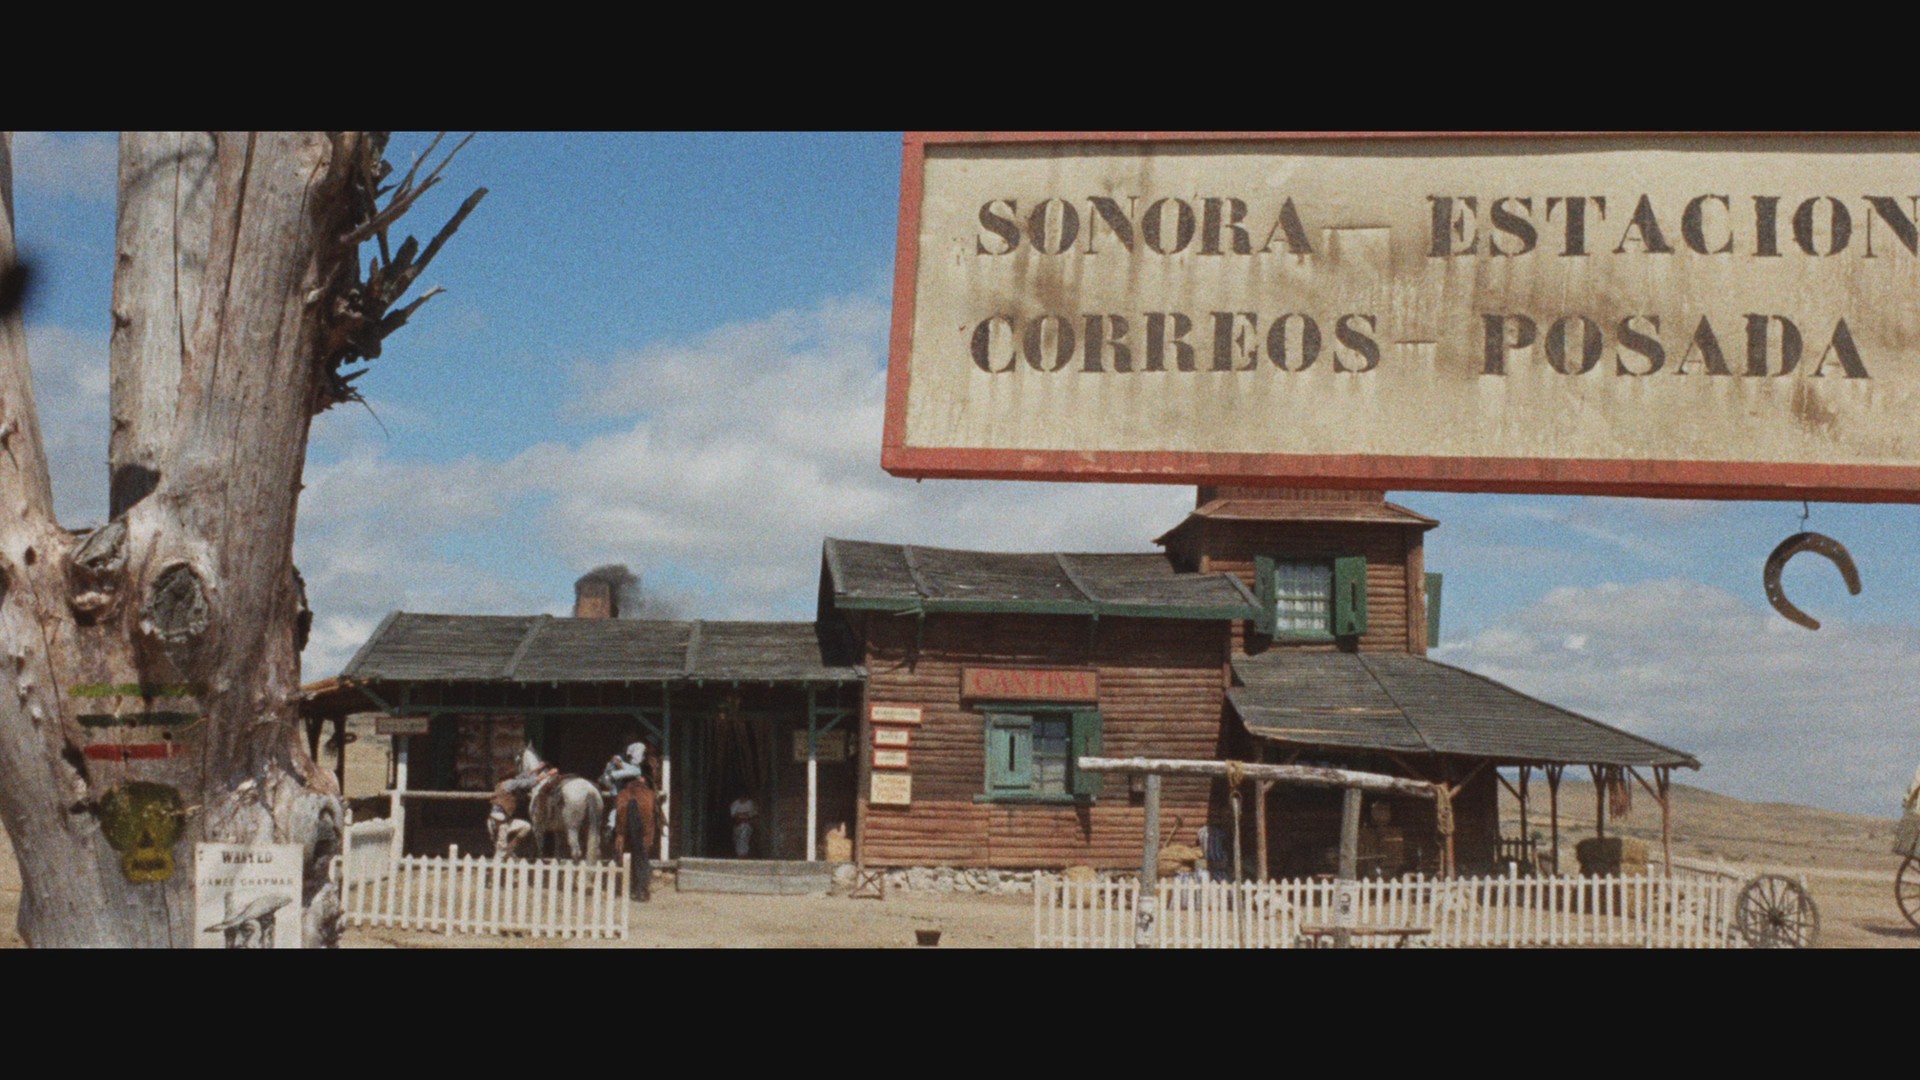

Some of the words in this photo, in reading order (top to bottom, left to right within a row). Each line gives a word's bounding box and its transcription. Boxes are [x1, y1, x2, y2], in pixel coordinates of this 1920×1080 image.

[976, 196, 1313, 256] SONORA
[1426, 194, 1920, 258] ESTACION
[970, 311, 1381, 374] CORREOS
[1480, 313, 1872, 379] POSADA
[973, 668, 1089, 696] CANTINA
[221, 850, 273, 864] WANTED
